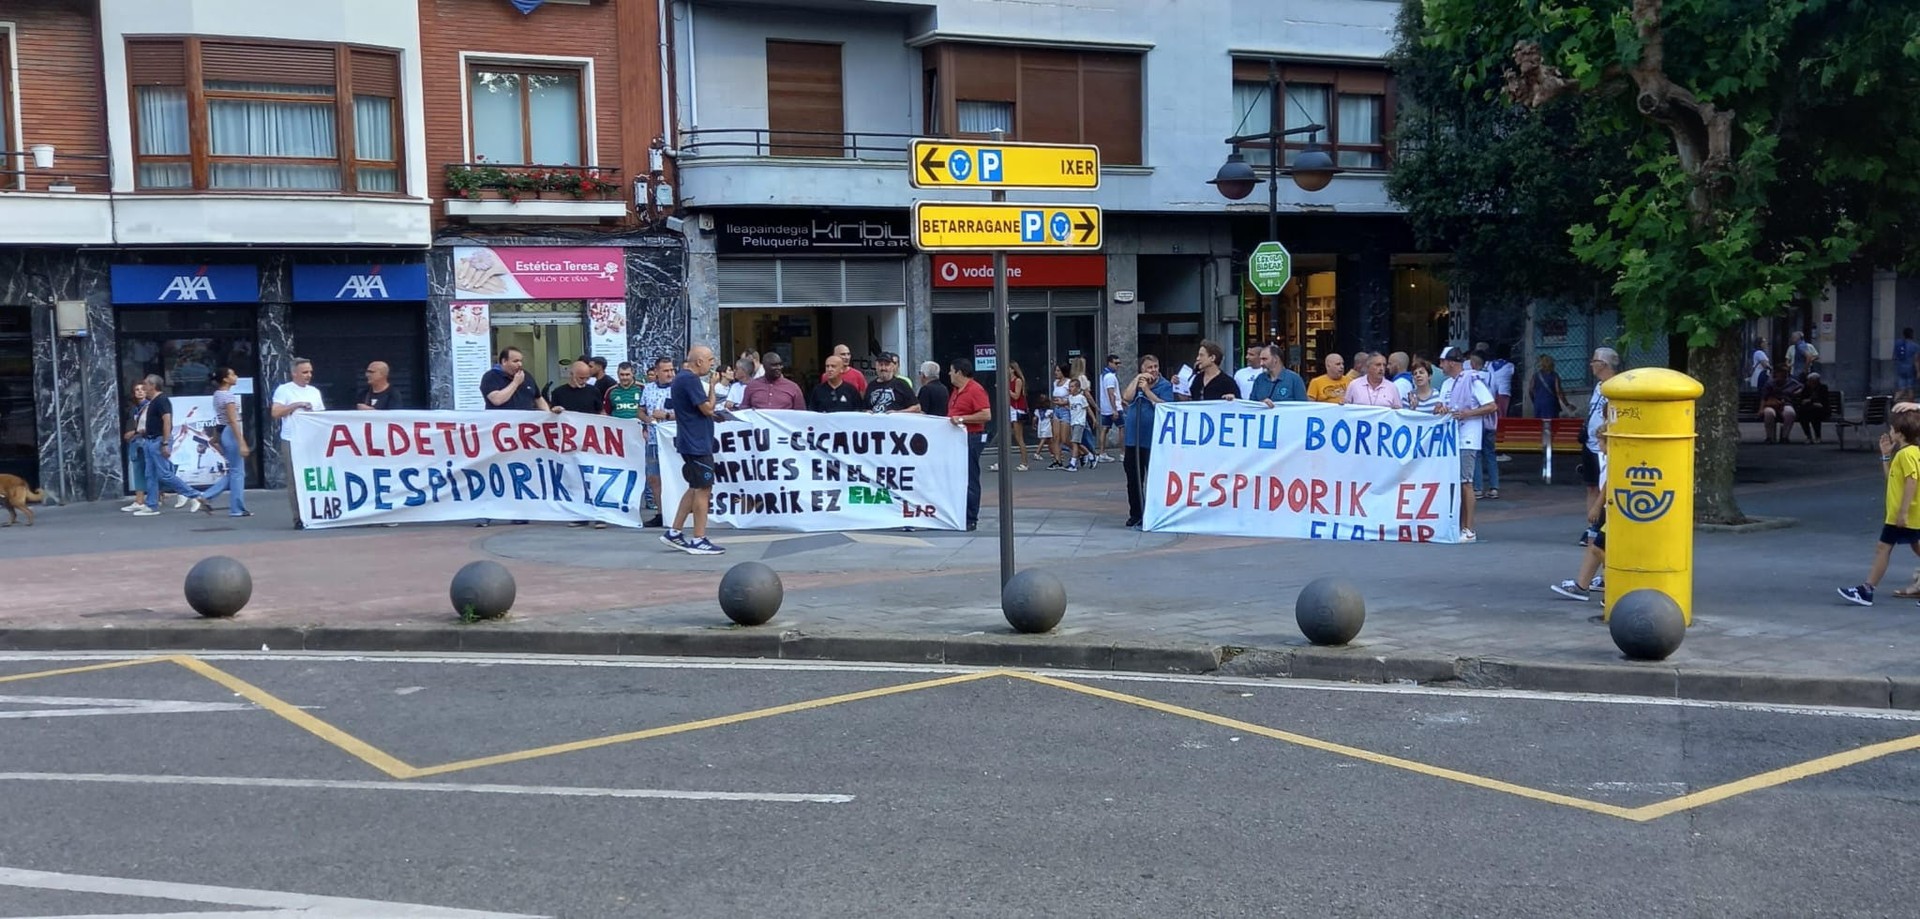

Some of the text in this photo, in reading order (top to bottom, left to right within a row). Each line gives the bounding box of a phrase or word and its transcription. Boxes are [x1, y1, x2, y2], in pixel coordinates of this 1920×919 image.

[1061, 160, 1094, 175] IXER
[922, 219, 1021, 234] BETARRAGANE
[863, 239, 910, 247] ileak
[515, 260, 600, 272] Estética Teresa
[962, 265, 1022, 277] vodane
[159, 276, 217, 300] AXA
[335, 275, 389, 298] AXA
[326, 422, 625, 458] ALDETU GREBAN
[1158, 411, 1458, 460] ALDETU BORROKAN
[303, 467, 336, 492] ELA
[812, 458, 840, 482] EN
[876, 466, 915, 491] ERE
[580, 466, 638, 513] EZ!
[811, 489, 841, 512] EZ
[1165, 471, 1372, 518] DESPIDORIK
[311, 497, 342, 520] LAB
